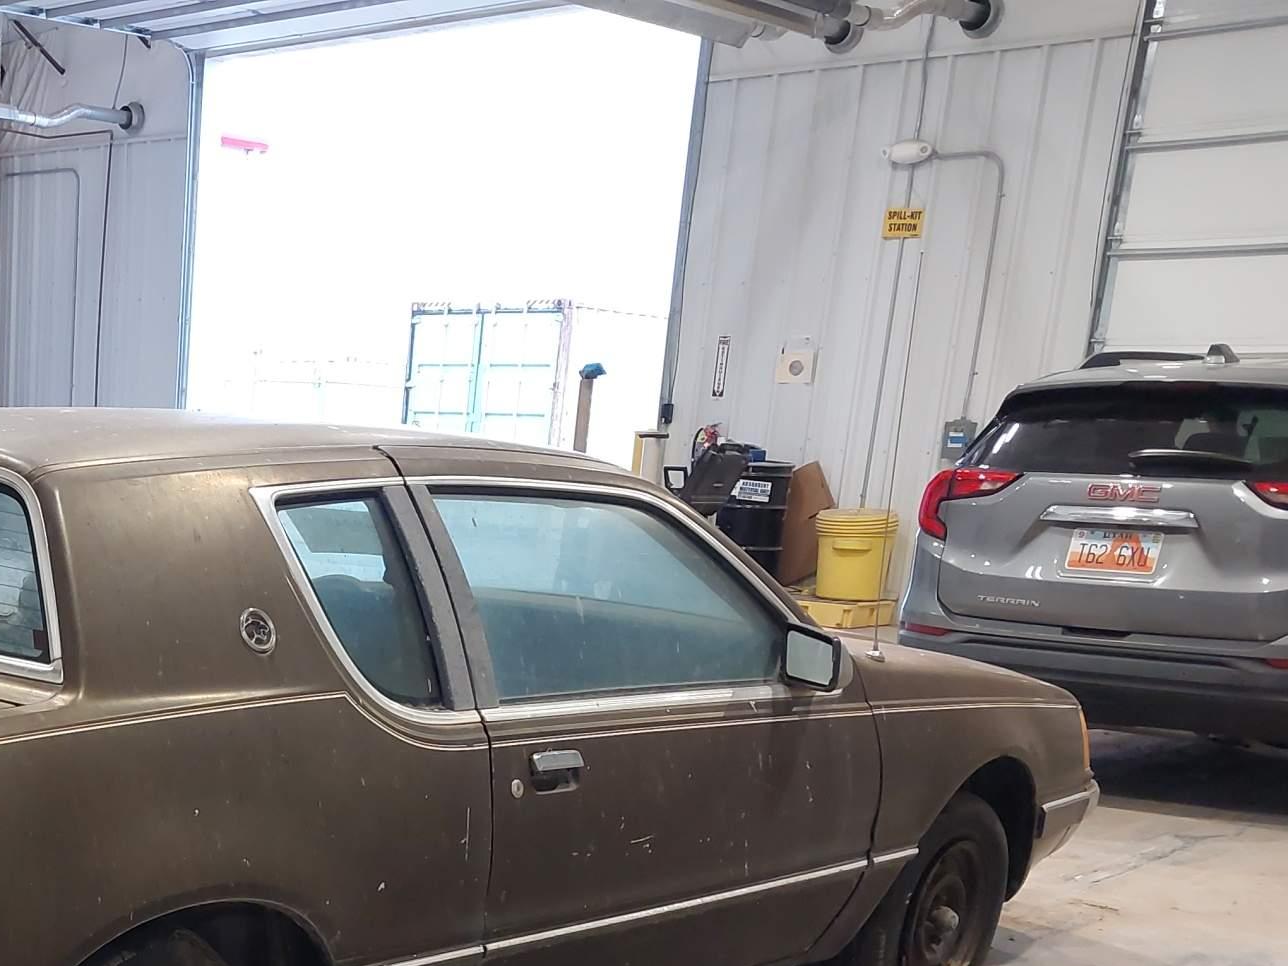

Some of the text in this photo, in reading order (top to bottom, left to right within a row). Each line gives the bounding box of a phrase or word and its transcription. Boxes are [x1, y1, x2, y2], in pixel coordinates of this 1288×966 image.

[888, 211, 922, 220] SPILL-KIT
[888, 223, 917, 232] STATION
[1088, 484, 1162, 503] GMC
[1078, 543, 1108, 564] T62
[977, 595, 1040, 607] TERRAIN
